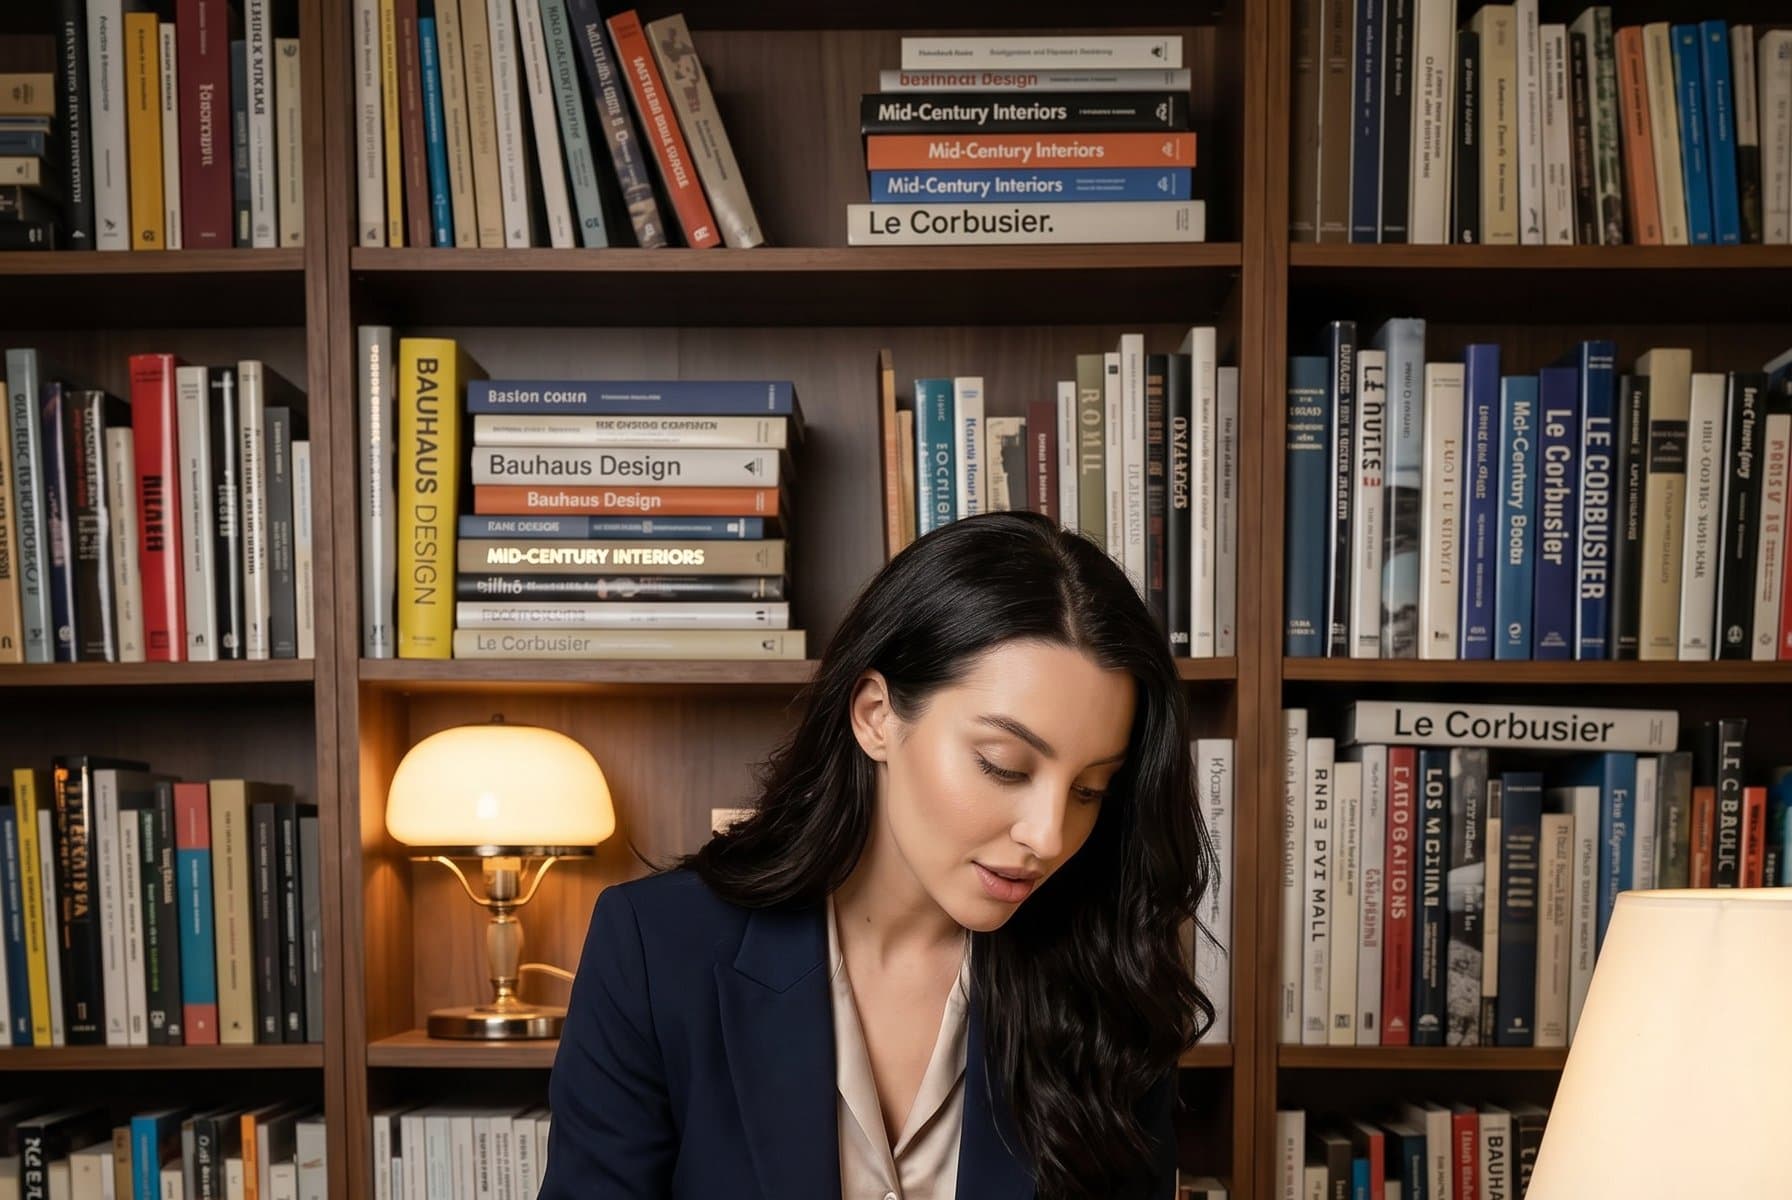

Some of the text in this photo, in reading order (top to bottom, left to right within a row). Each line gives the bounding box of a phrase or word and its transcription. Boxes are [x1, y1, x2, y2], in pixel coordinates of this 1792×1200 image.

[878, 102, 1067, 125] Mid-Century Interiors
[929, 140, 1104, 163] Mid-Century Interiors
[887, 175, 1063, 198] Mid-Century Interiors
[869, 209, 1054, 235] Le Corbusier.
[490, 453, 682, 481] Bauhaus Design
[414, 357, 439, 606] BAUHAUS DESIGN
[1543, 409, 1572, 566] Le Corbusier
[527, 491, 662, 511] Bauhaus Design
[1581, 417, 1611, 600] LE CORBUSIER
[487, 548, 705, 565] MID-CENTURY INTERIORS
[477, 634, 591, 652] Le Corbusier
[1393, 708, 1616, 743] Le Corbusier
[1311, 888, 1326, 943] MALL
